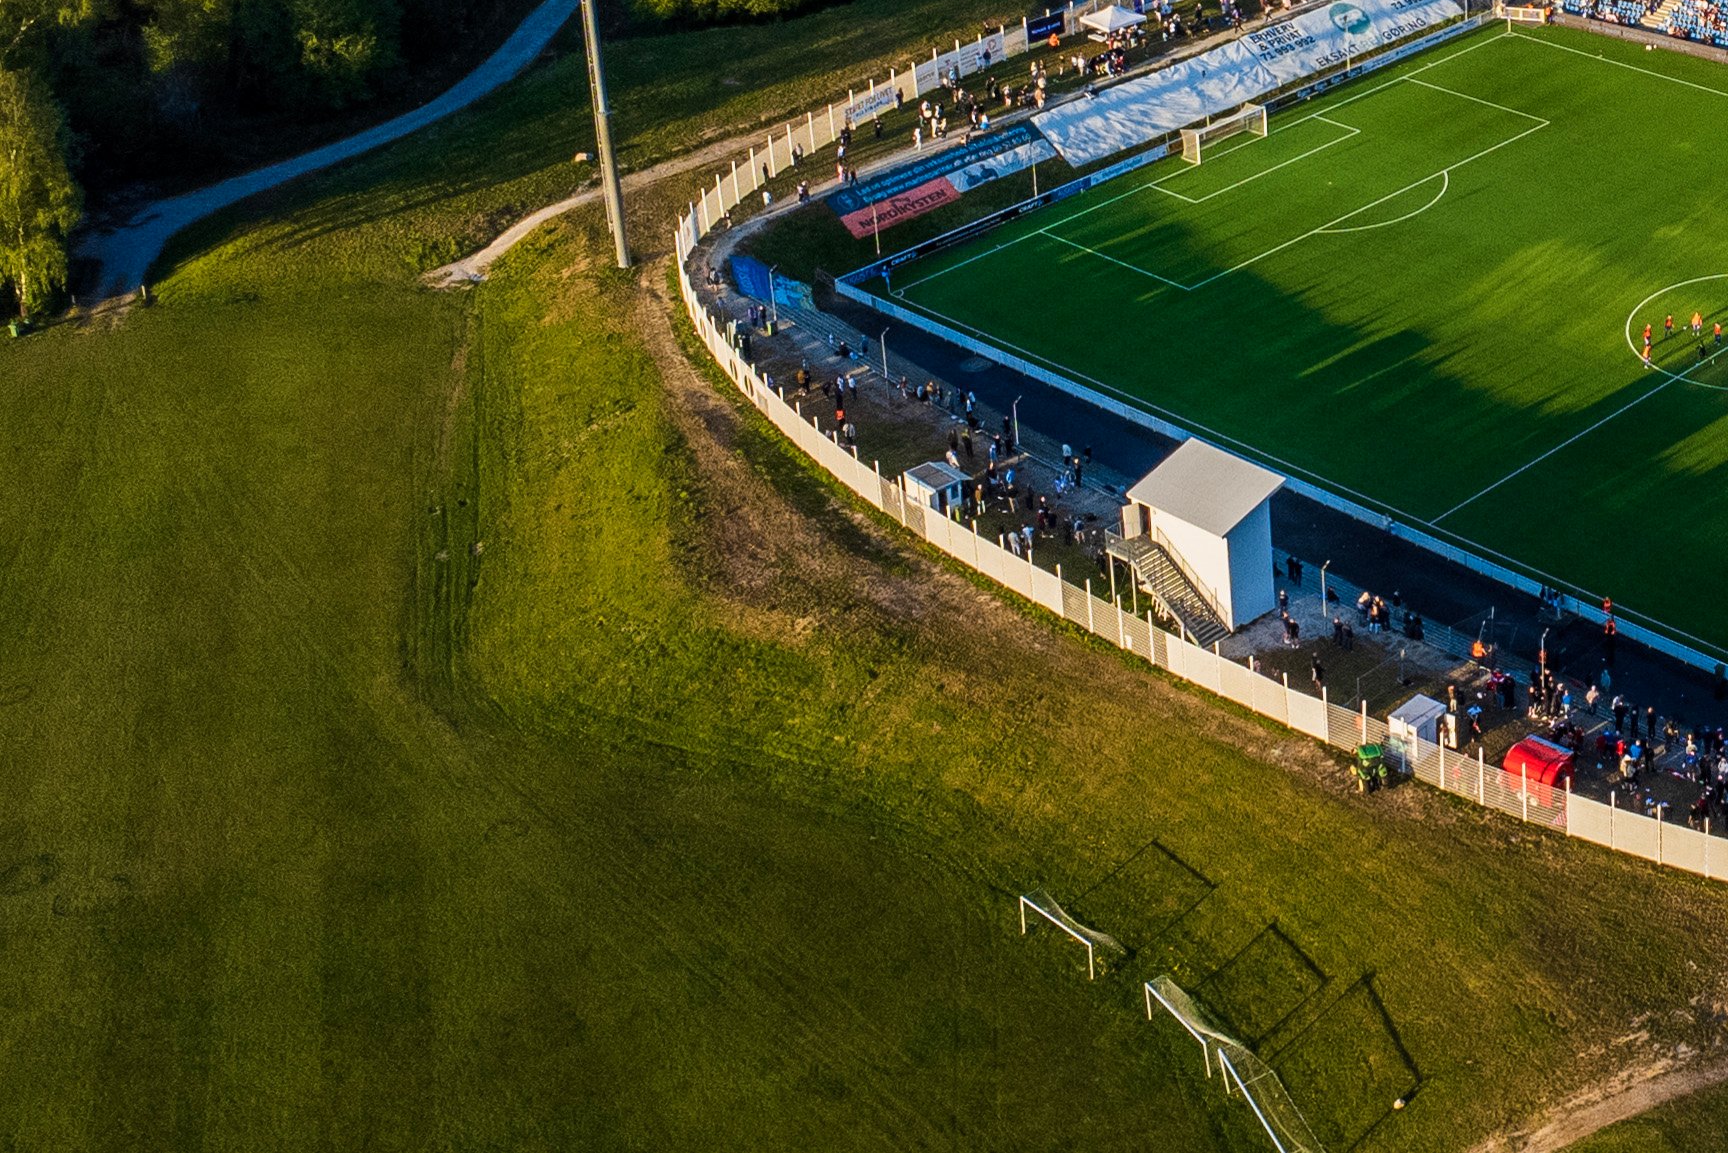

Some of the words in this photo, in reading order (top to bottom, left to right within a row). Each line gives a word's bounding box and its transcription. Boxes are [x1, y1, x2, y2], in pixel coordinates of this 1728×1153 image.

[1391, 1, 1403, 11] 71
[1250, 21, 1296, 44] ERHVERV
[1269, 31, 1303, 50] PRIVAT
[1259, 51, 1272, 62] 71
[1275, 43, 1297, 57] 993
[1295, 35, 1316, 50] 992
[1315, 44, 1362, 68] EKSAKT
